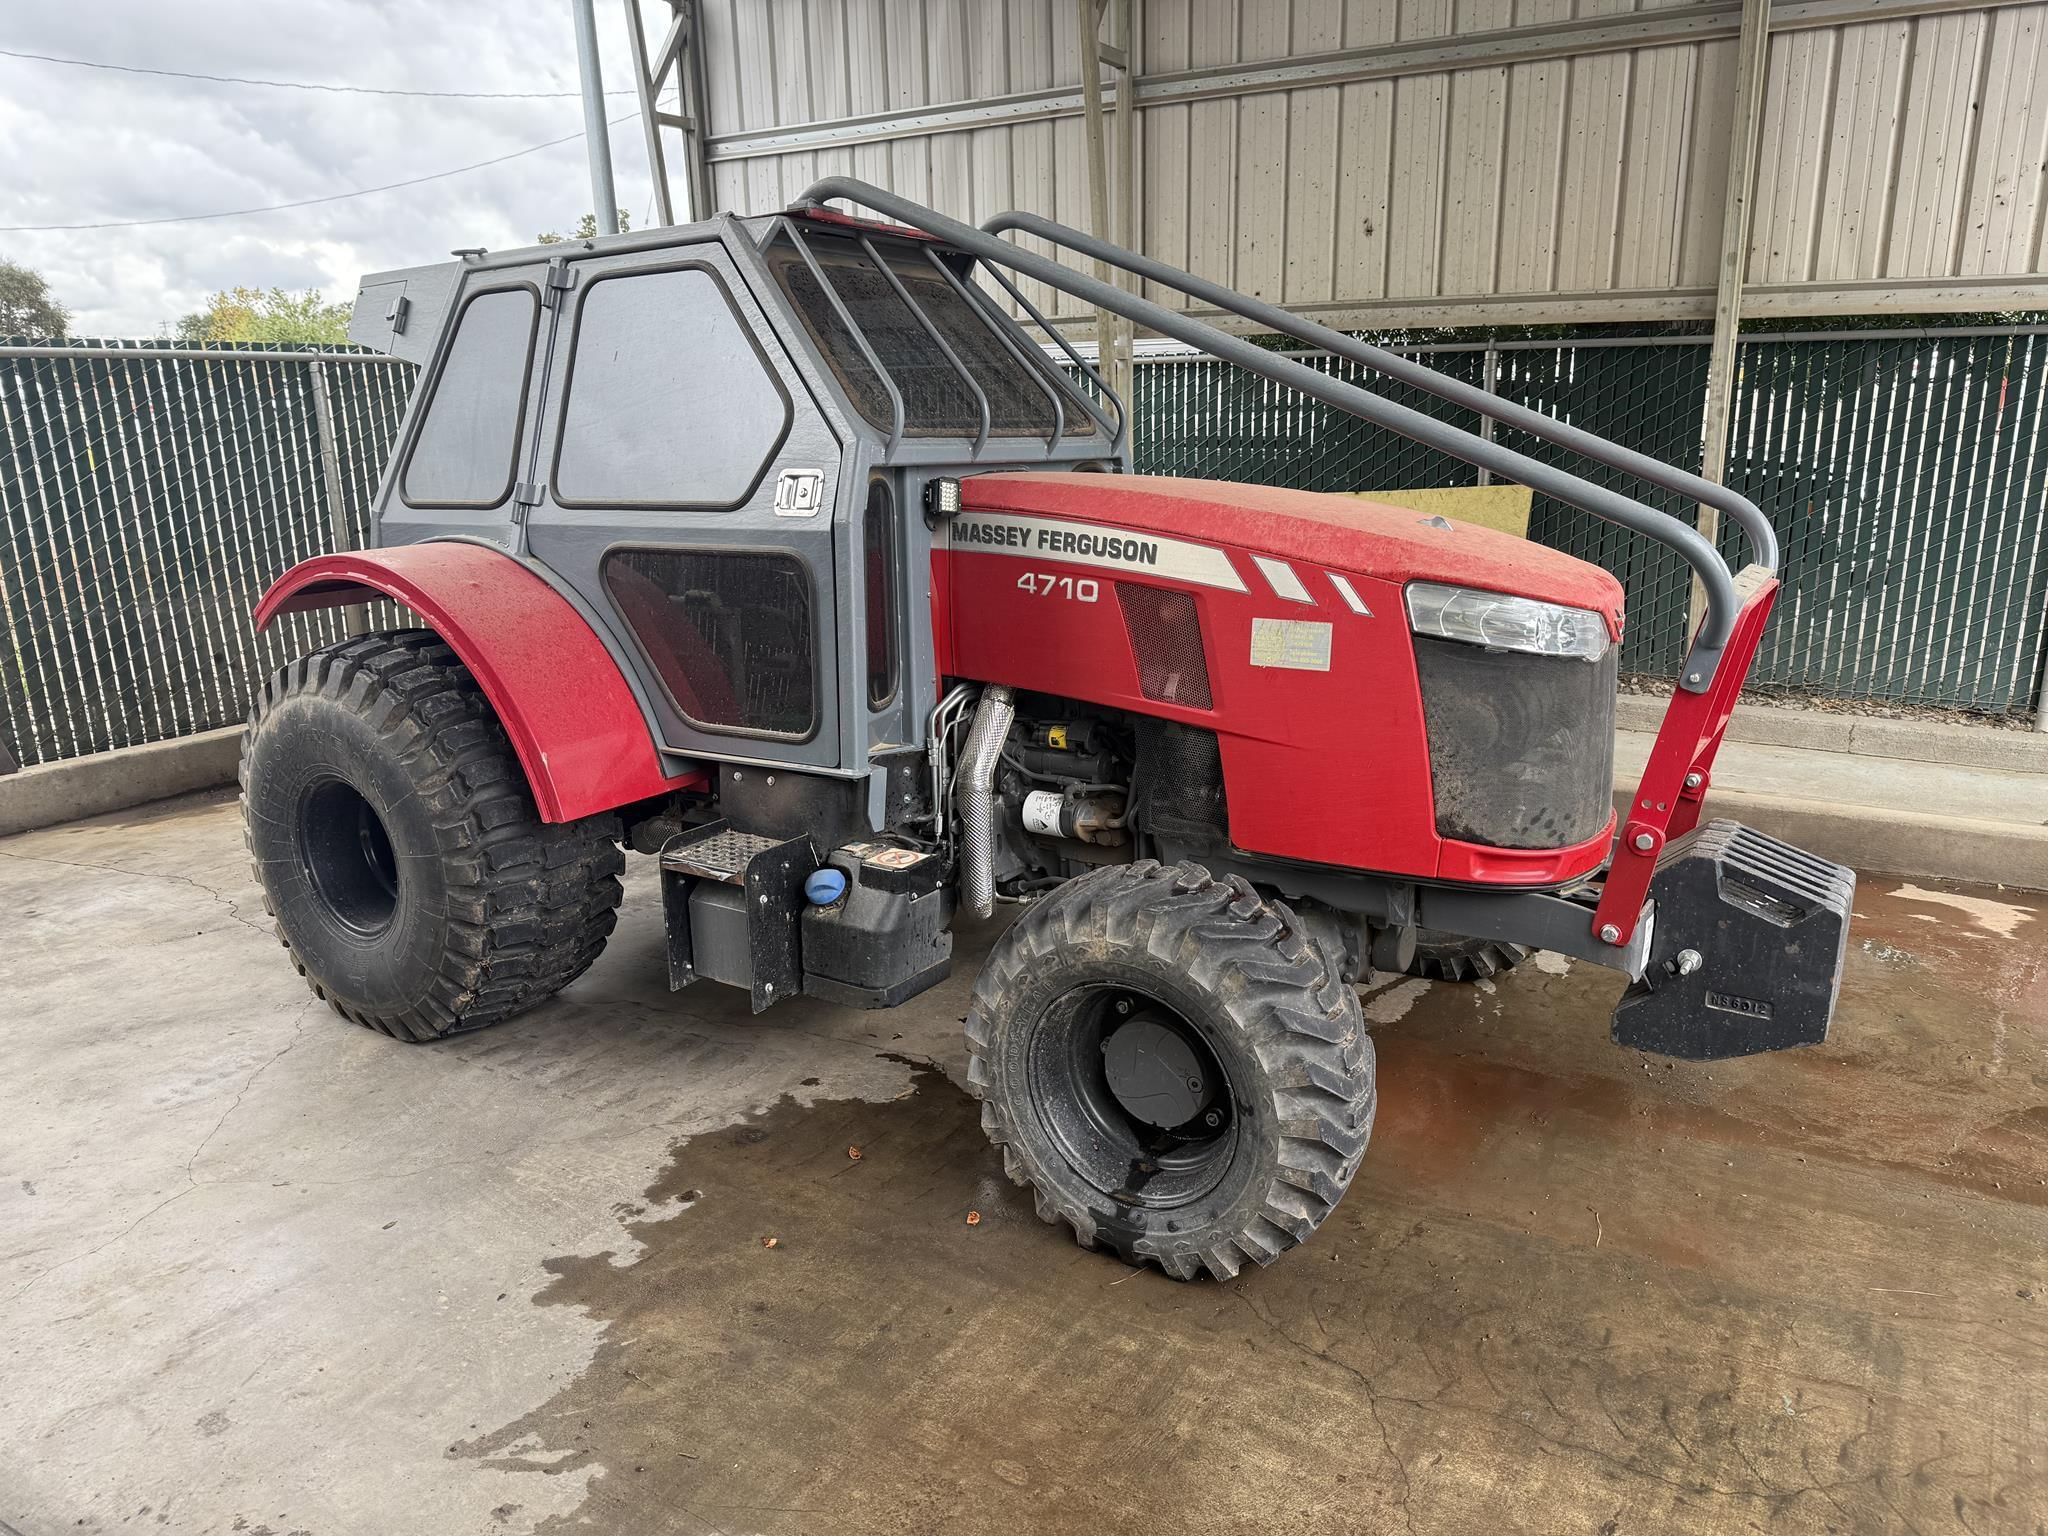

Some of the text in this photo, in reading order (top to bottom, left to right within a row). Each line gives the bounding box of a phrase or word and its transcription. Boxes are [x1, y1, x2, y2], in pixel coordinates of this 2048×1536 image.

[951, 521, 1158, 565] MASSEY FERGUSON
[1017, 572, 1099, 603] 4710
